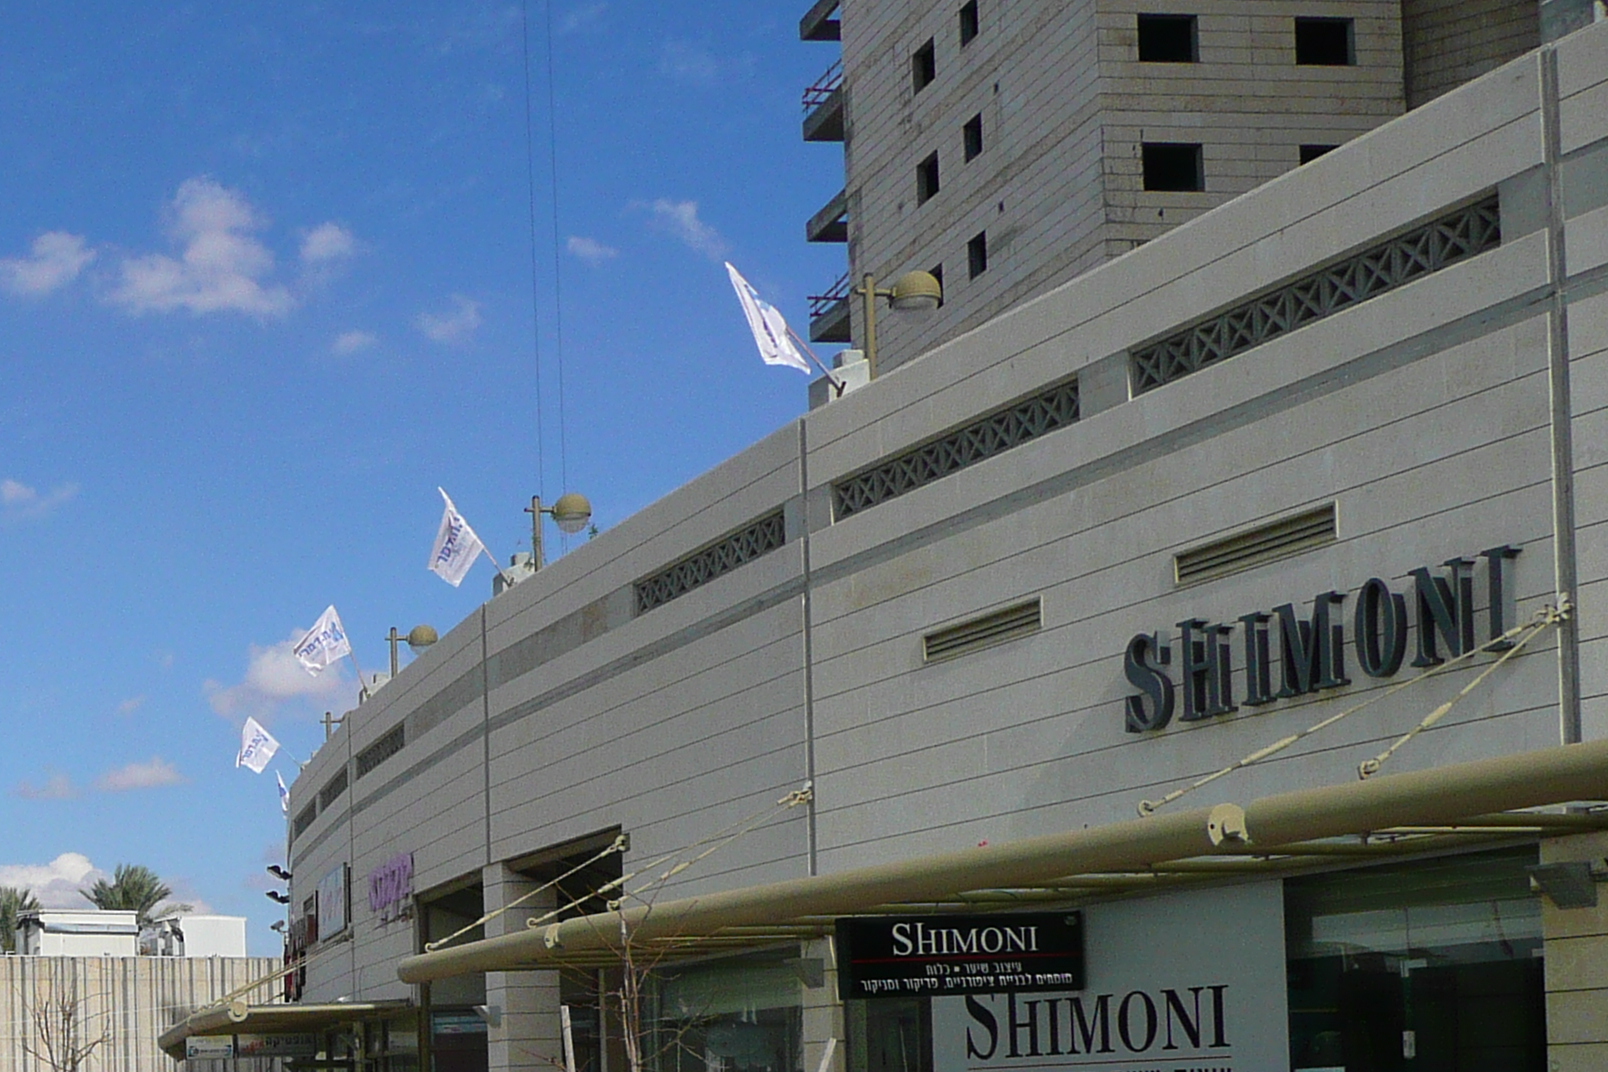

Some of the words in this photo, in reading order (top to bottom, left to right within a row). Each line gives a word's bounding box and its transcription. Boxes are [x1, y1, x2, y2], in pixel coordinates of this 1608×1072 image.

[1124, 544, 1524, 733] SHIMONI
[892, 922, 1040, 955] SHIMONI
[925, 963, 951, 976] כלות
[962, 963, 990, 975] שיער
[993, 962, 1023, 973] עיצוב
[860, 979, 900, 995] ומניקור
[902, 978, 939, 993] פדיקור
[965, 985, 1232, 1060] SHIMONI
